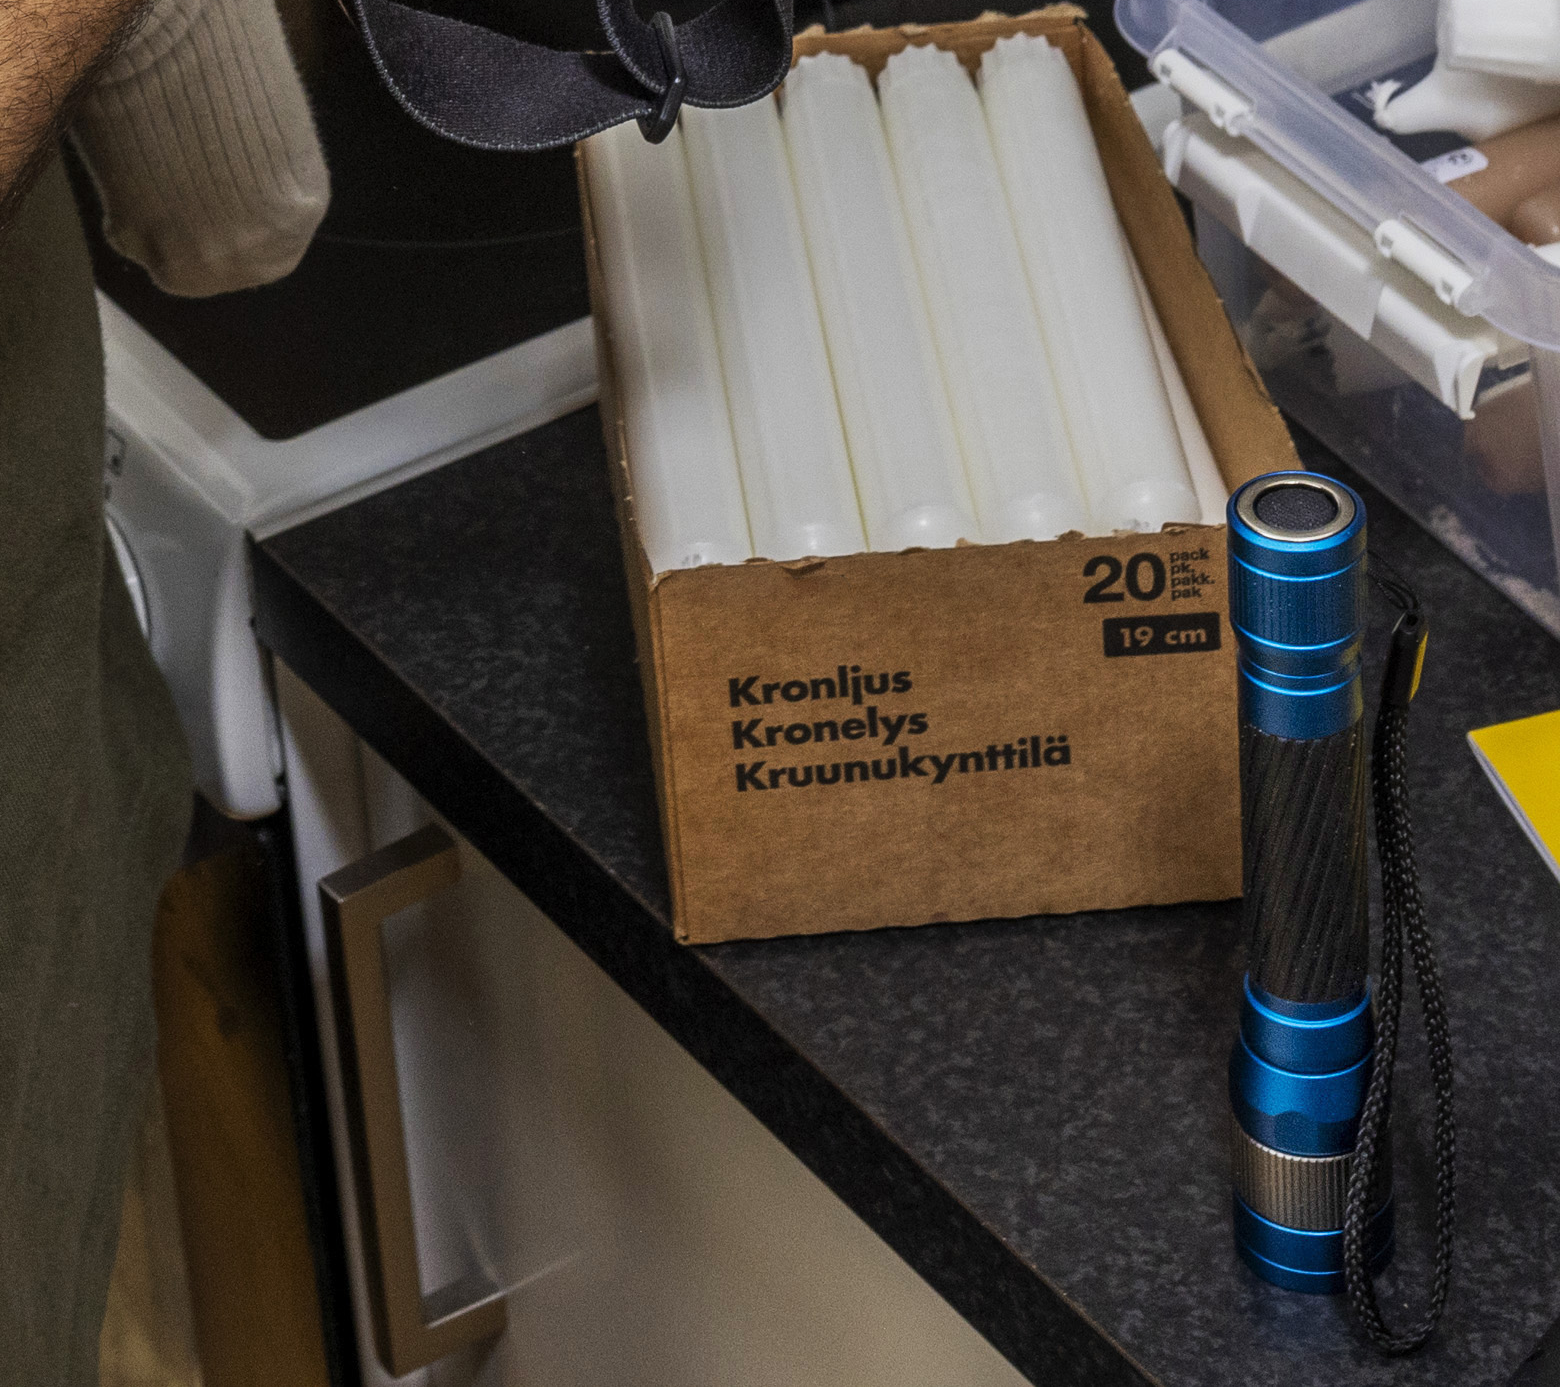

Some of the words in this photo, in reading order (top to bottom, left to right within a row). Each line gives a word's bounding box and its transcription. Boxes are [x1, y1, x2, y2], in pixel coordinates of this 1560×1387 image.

[1169, 548, 1209, 563] pack
[1083, 552, 1166, 603] 20
[1170, 562, 1195, 575] pk.
[1171, 573, 1215, 587] pakk.
[1171, 586, 1202, 601] pak
[1120, 626, 1154, 648] 19
[1164, 628, 1207, 645] cm
[729, 665, 913, 707] Kronljus
[732, 706, 929, 749] Kronelys
[735, 735, 1071, 792] Kruunukynttilä
